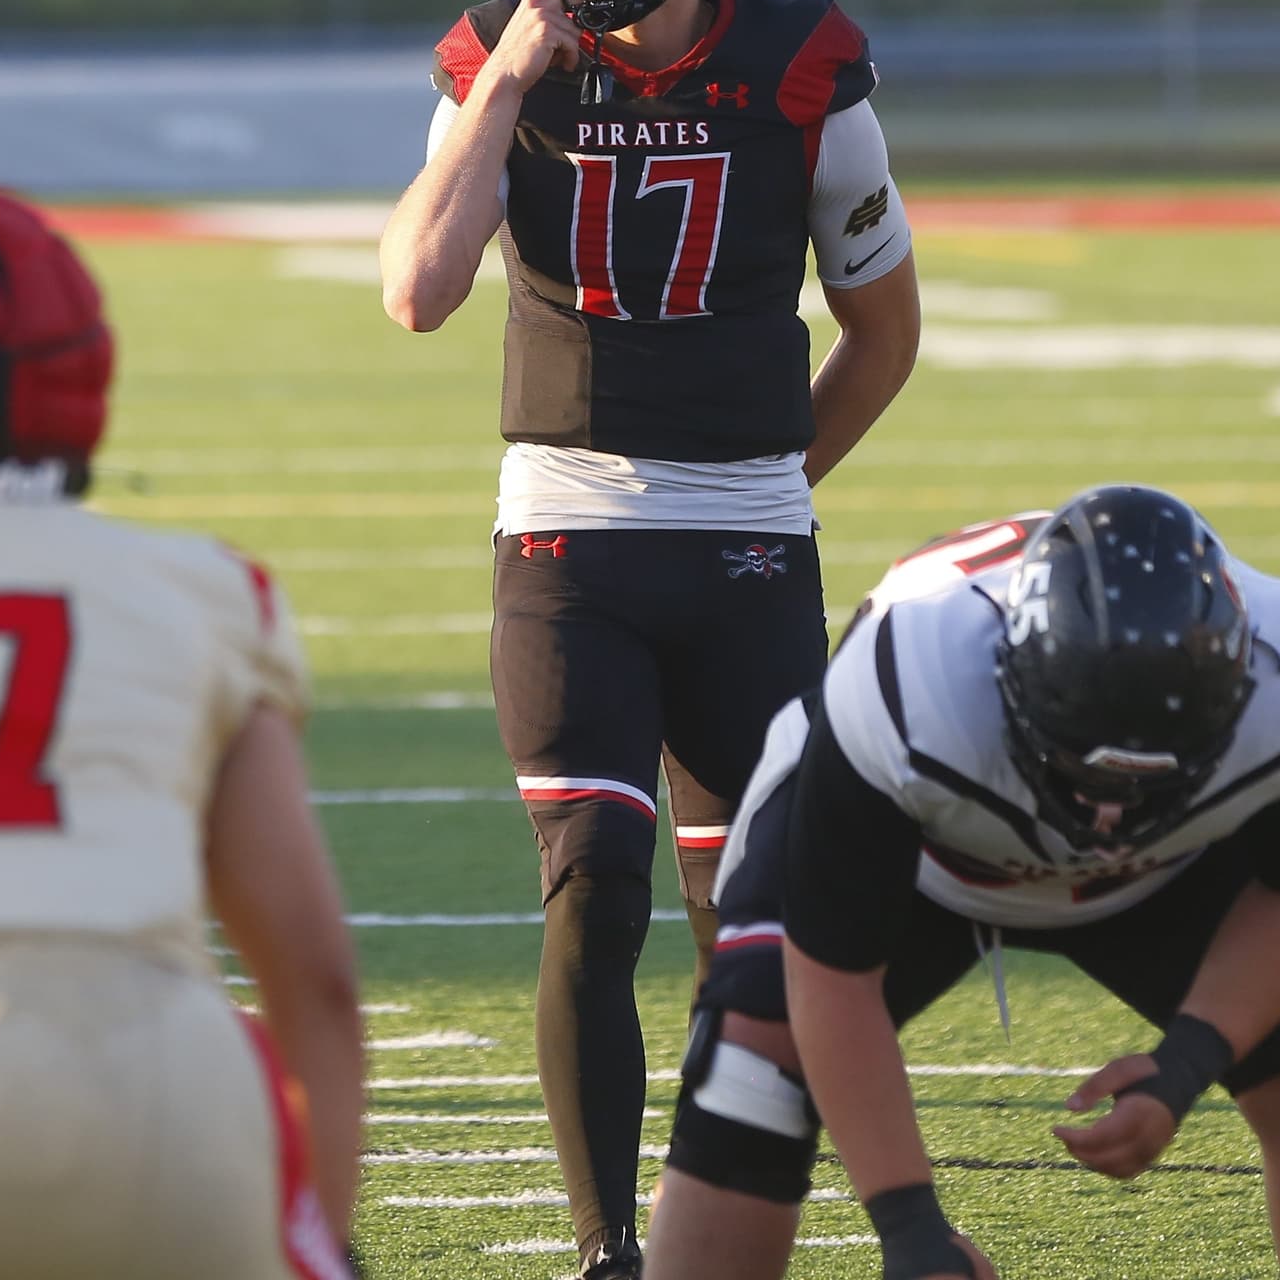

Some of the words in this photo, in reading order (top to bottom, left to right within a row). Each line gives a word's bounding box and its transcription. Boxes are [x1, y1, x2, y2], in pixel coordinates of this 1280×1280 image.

[577, 121, 710, 147] PIRATES
[564, 151, 732, 320] 17
[1006, 560, 1053, 647] 55
